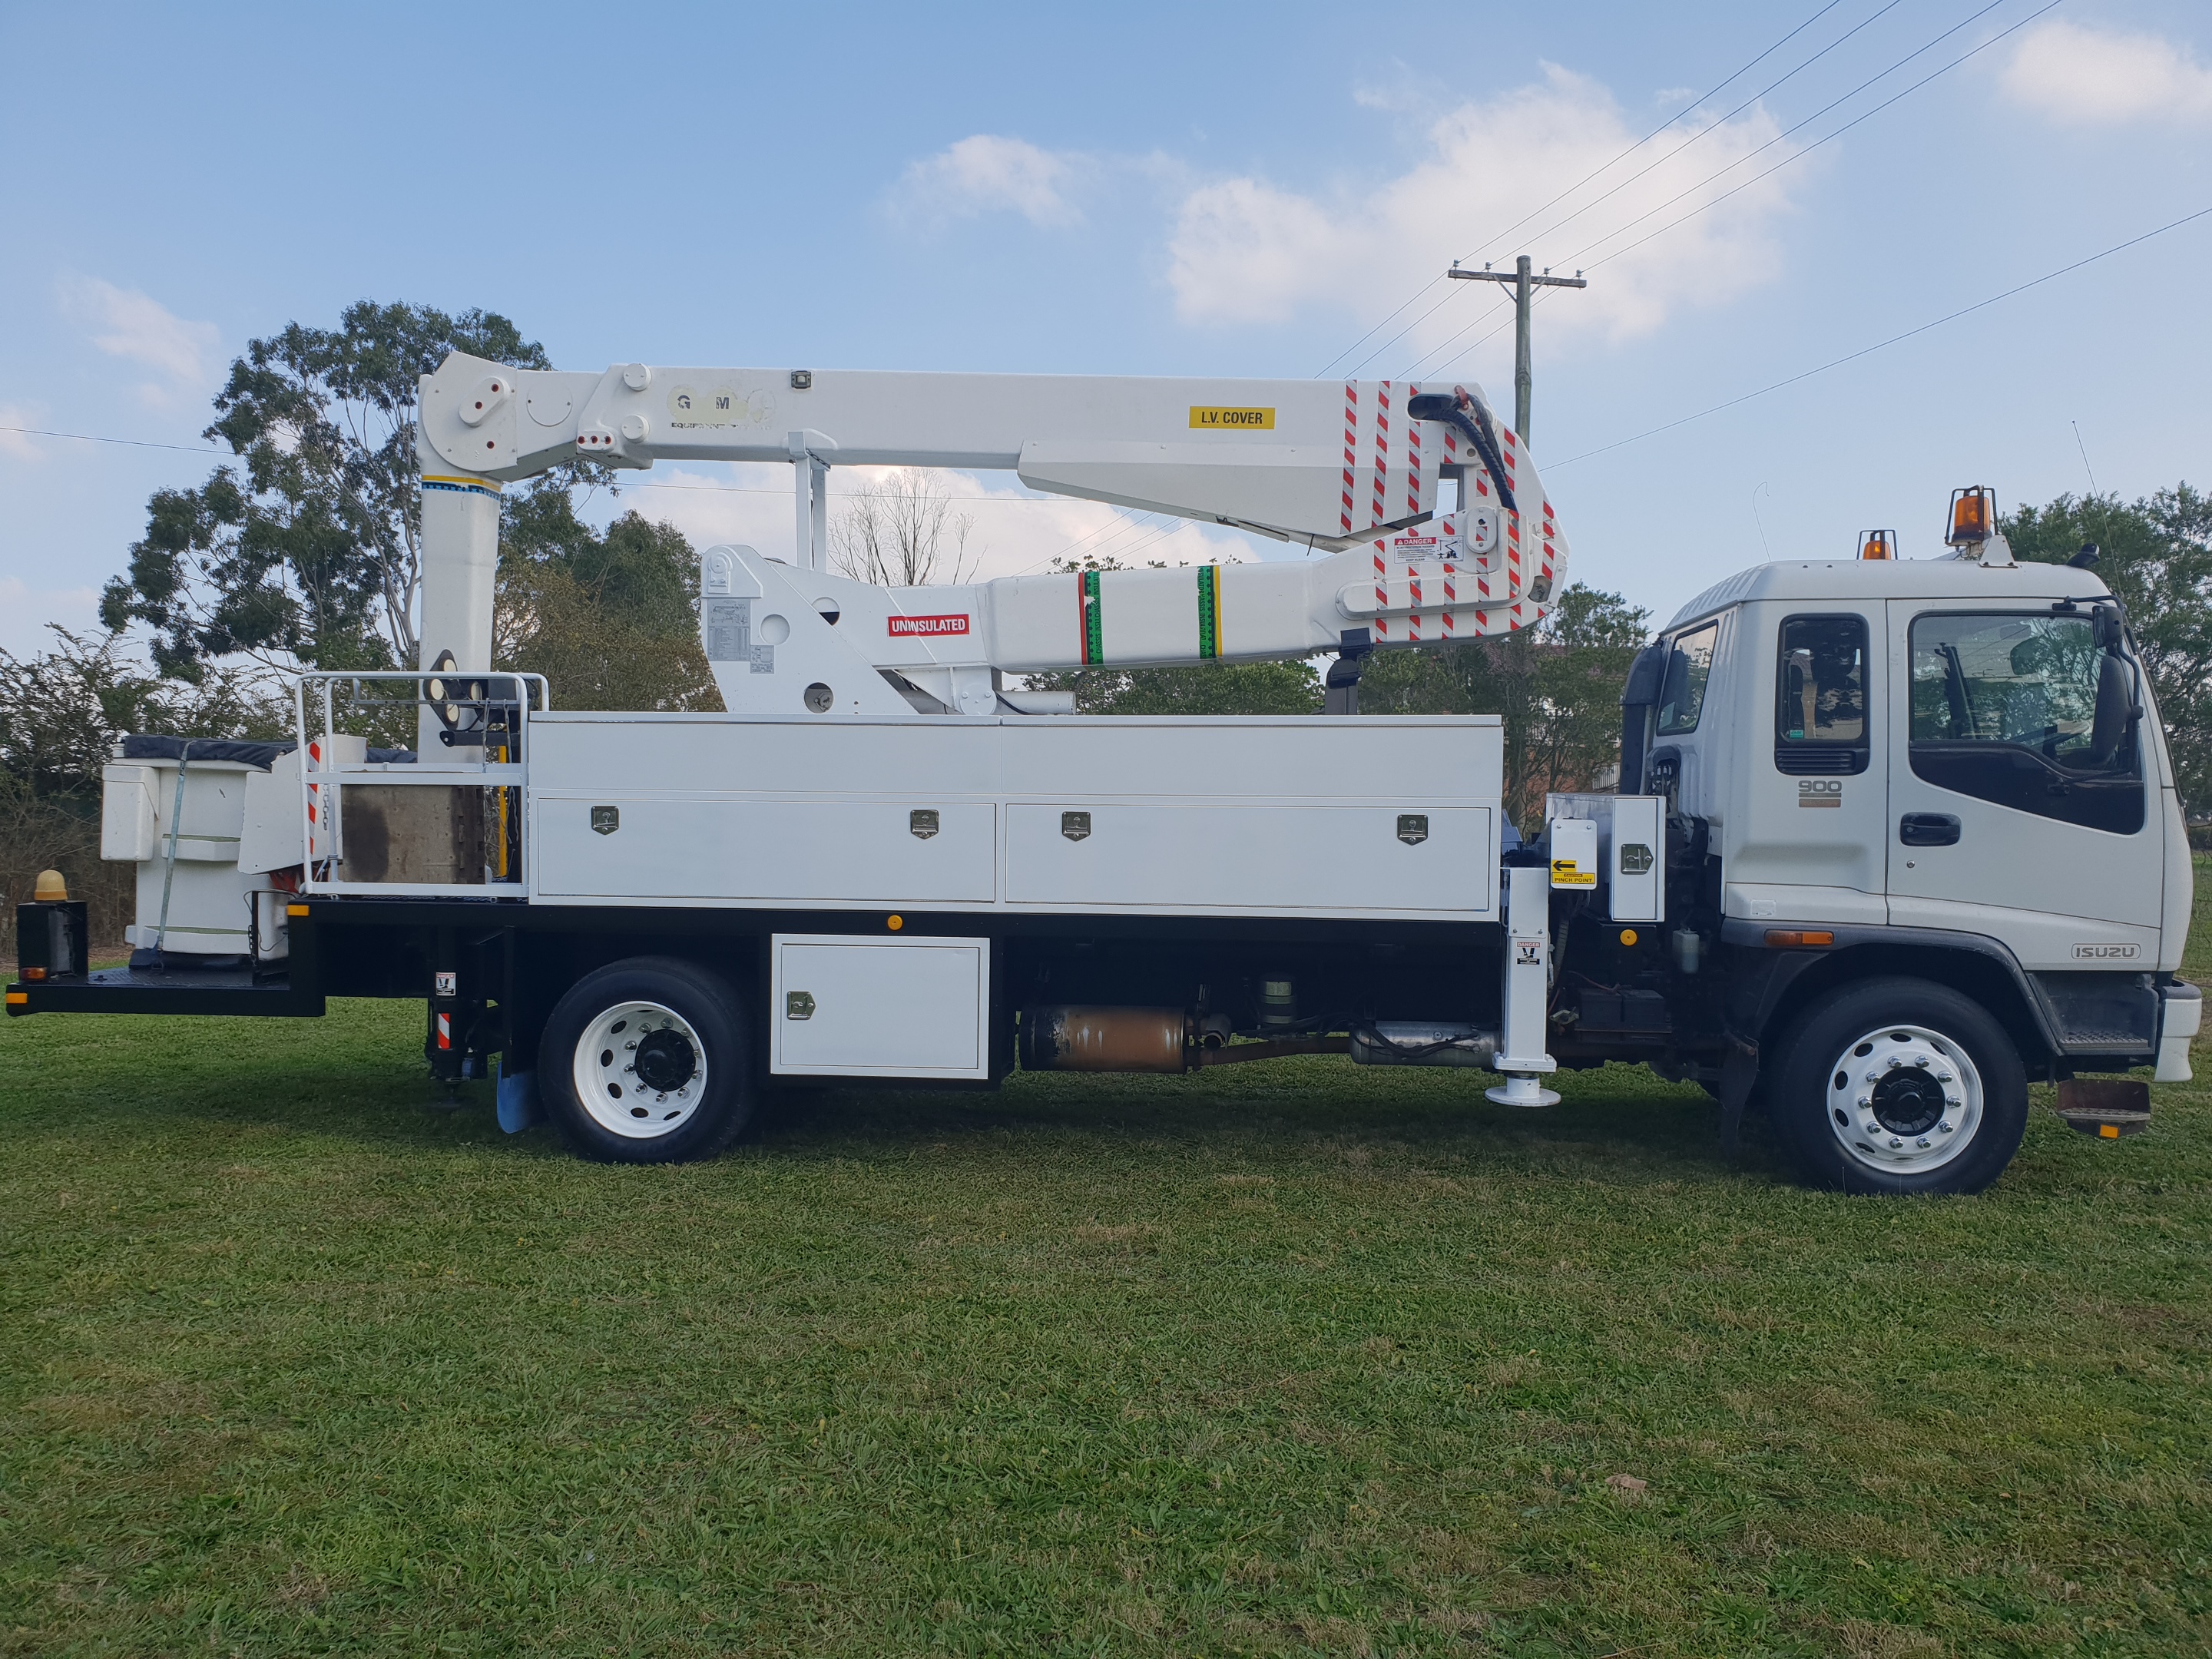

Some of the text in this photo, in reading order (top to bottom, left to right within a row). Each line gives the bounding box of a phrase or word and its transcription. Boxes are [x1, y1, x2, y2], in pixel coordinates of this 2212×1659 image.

[677, 394, 730, 409] G M
[1201, 411, 1263, 424] L.V. COVER
[892, 618, 965, 633] UNINSULATED
[1798, 780, 1842, 792] 900
[2076, 947, 2134, 958] ISUZU
